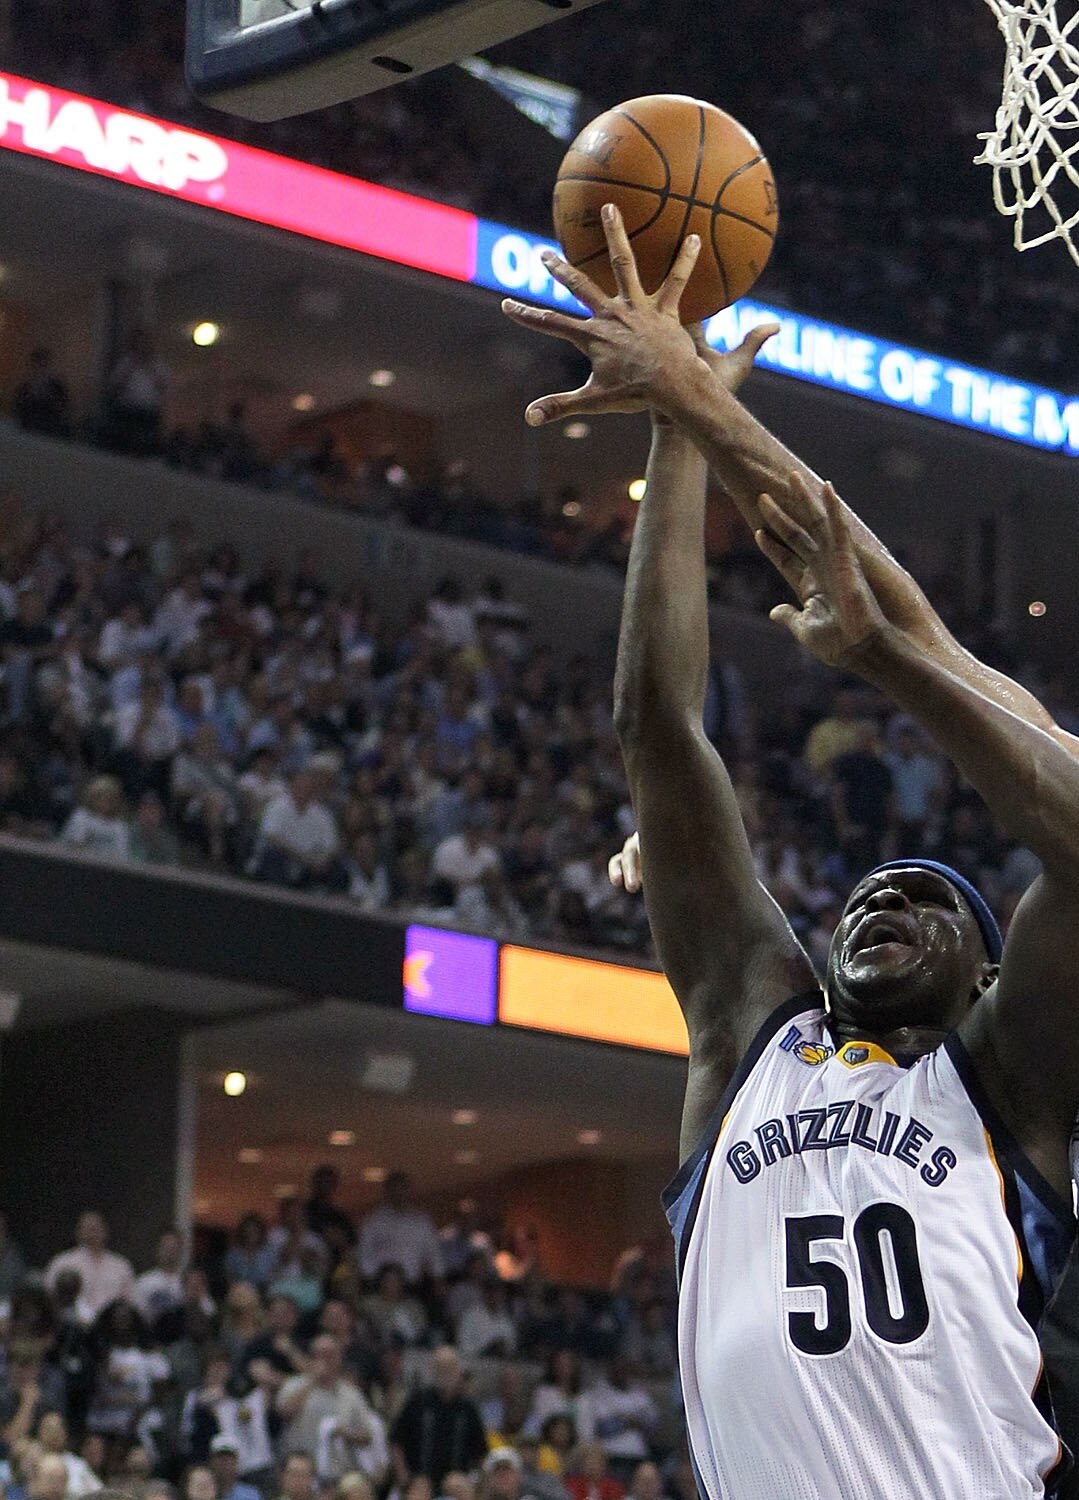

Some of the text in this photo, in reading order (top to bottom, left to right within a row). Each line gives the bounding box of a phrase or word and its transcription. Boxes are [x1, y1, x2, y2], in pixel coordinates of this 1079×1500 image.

[879, 350, 941, 406] OF
[945, 369, 1031, 436] THE
[726, 1099, 958, 1187] GRIZZLIES
[782, 1202, 931, 1356] 50
